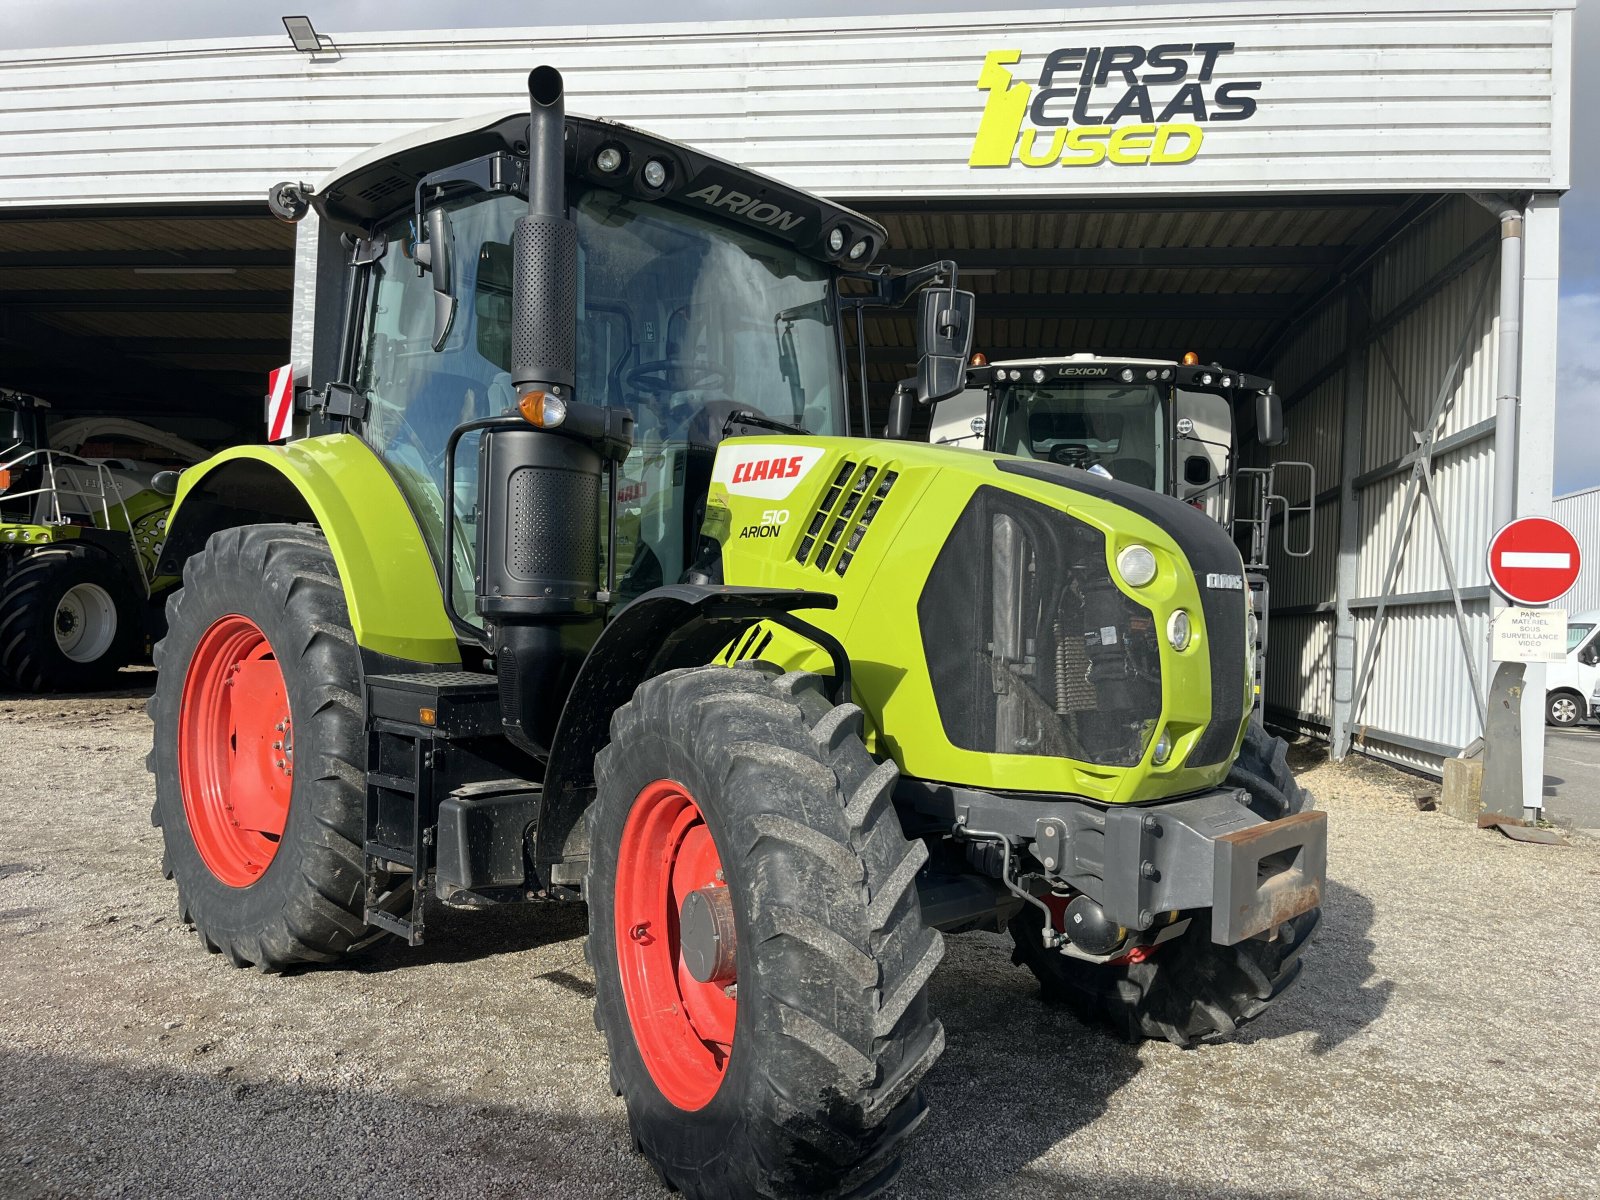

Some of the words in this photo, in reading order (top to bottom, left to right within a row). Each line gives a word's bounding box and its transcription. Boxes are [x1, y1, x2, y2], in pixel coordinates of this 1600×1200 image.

[1038, 42, 1235, 86] FIRST
[1030, 82, 1262, 126] CLAAS
[1019, 124, 1204, 166] USED
[685, 184, 806, 231] ARION
[1058, 368, 1108, 376] LEXION
[732, 456, 803, 484] CLAAS
[760, 509, 790, 525] 510
[739, 525, 781, 538] ARION
[1501, 632, 1559, 640] SURVEILLANCE
